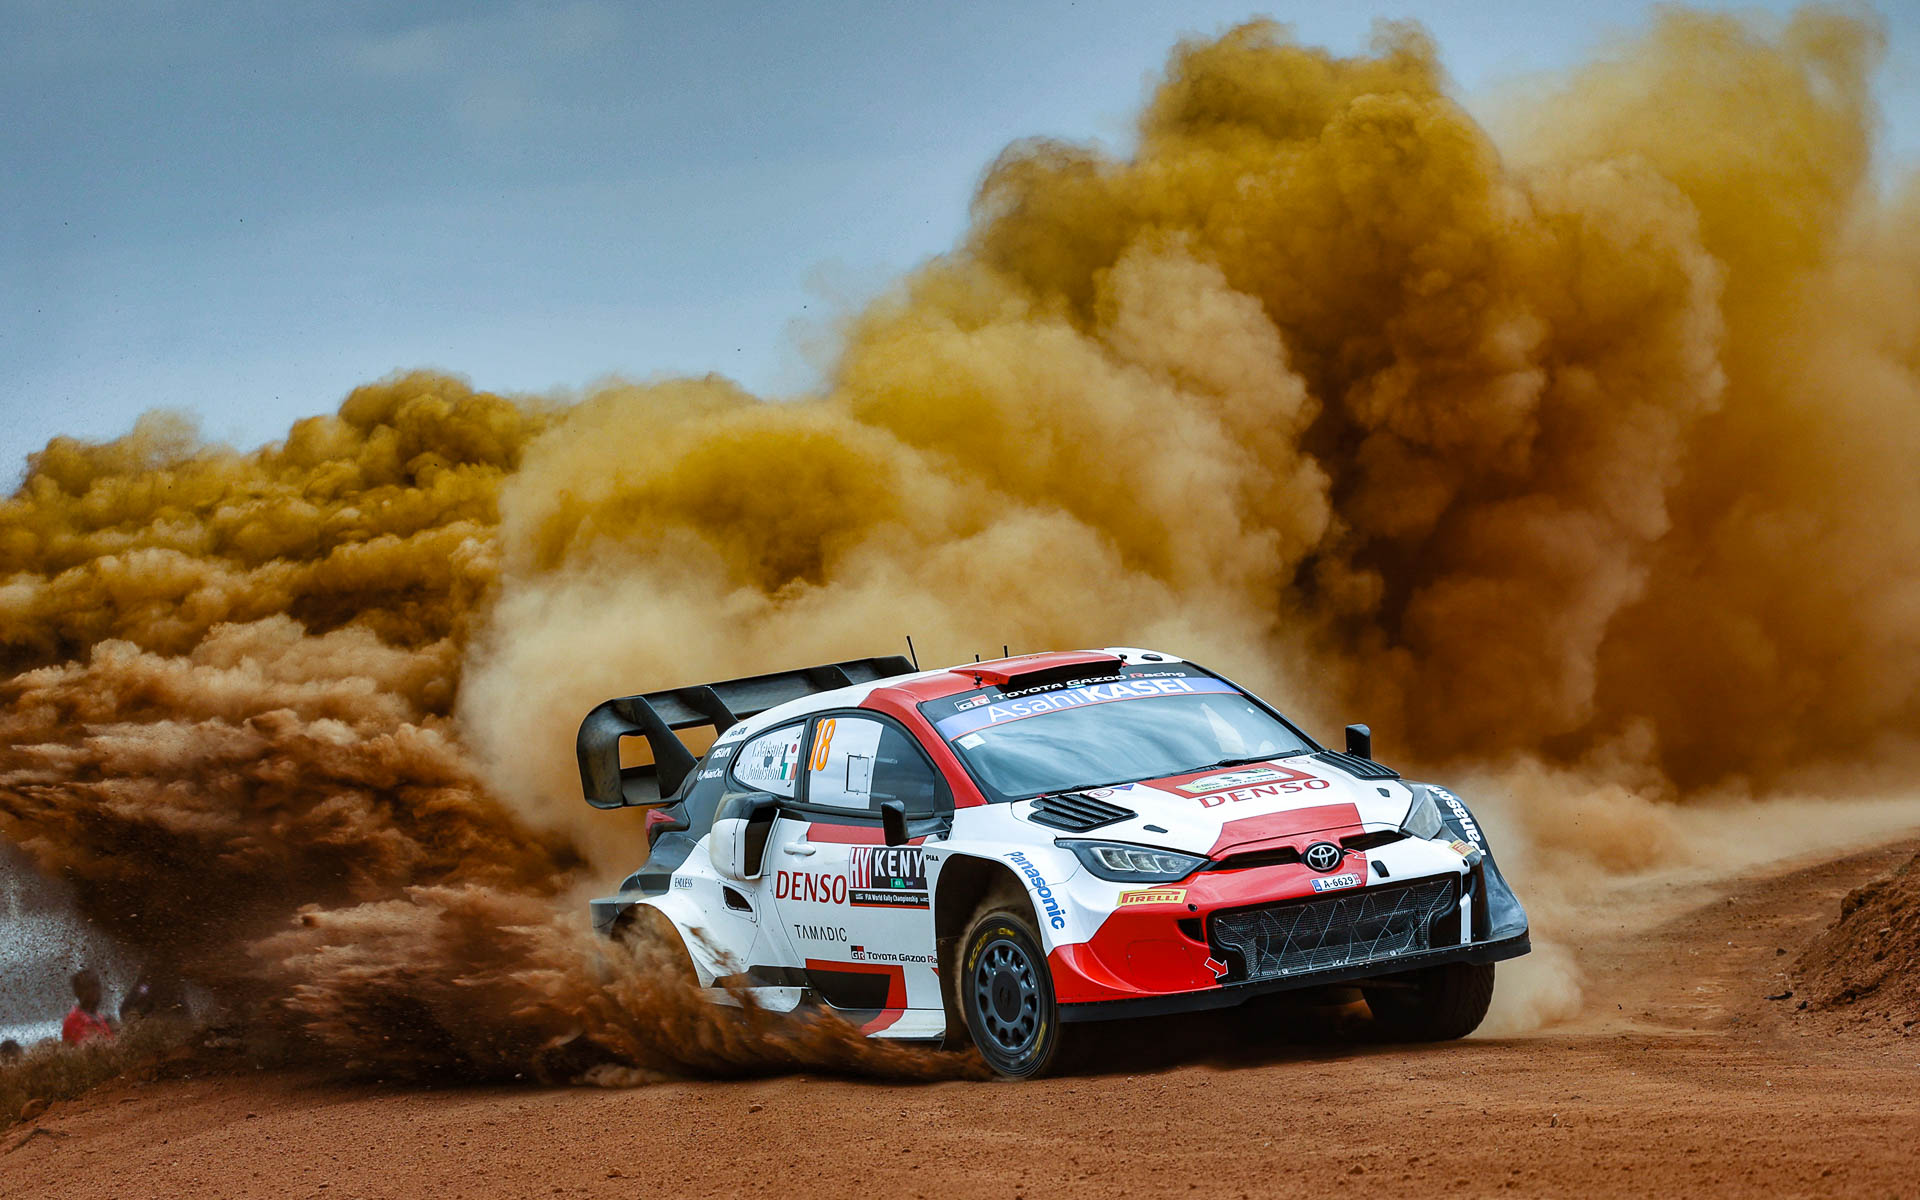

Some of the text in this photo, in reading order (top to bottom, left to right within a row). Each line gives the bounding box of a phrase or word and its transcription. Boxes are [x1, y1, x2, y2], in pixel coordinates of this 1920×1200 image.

[958, 671, 1187, 711] GR TOYOTA GAZOO Racing
[807, 717, 837, 772] 18
[1198, 780, 1331, 809] DENSO
[850, 847, 926, 888] HY KENY
[1323, 876, 1354, 888] A-6629
[776, 870, 847, 904] DENSO
[1003, 851, 1066, 930] Panasonic
[1120, 890, 1182, 904] PIRELLI
[793, 924, 847, 942] TAMADIC
[852, 951, 865, 960] GR
[866, 951, 897, 961] TOYOTA
[898, 953, 926, 963] GAZOO
